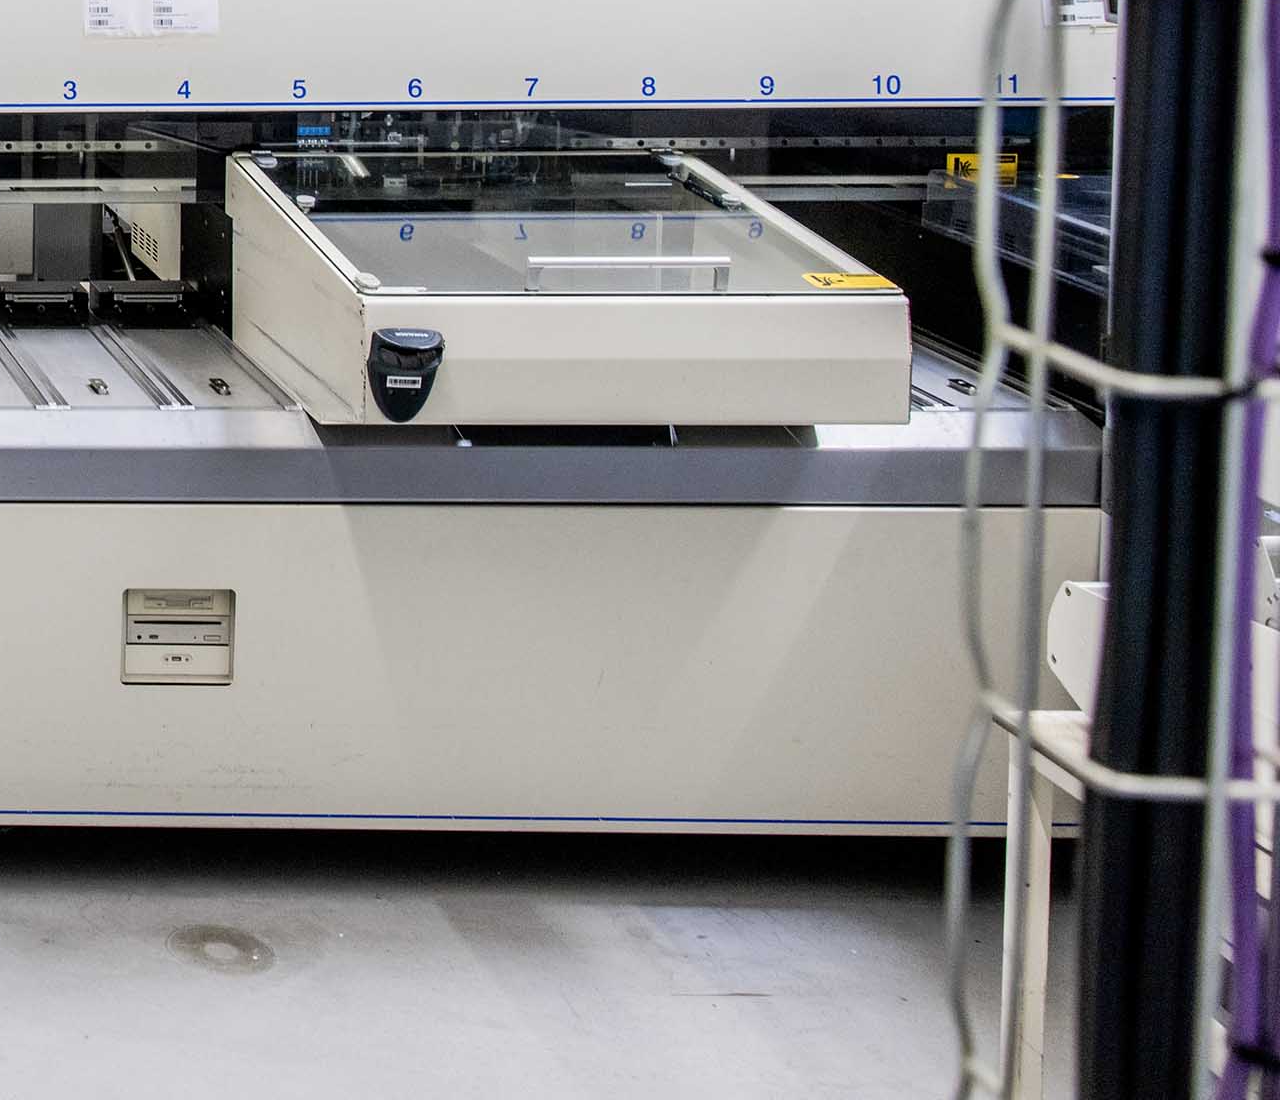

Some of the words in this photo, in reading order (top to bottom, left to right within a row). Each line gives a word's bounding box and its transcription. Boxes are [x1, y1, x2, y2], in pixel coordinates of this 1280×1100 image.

[63, 80, 78, 101] 3
[176, 80, 191, 100] 4
[292, 80, 308, 100] 5
[407, 78, 423, 100] 6
[525, 77, 540, 98] 7
[641, 76, 657, 98] 8
[759, 75, 775, 97] 9
[873, 74, 902, 96] 10
